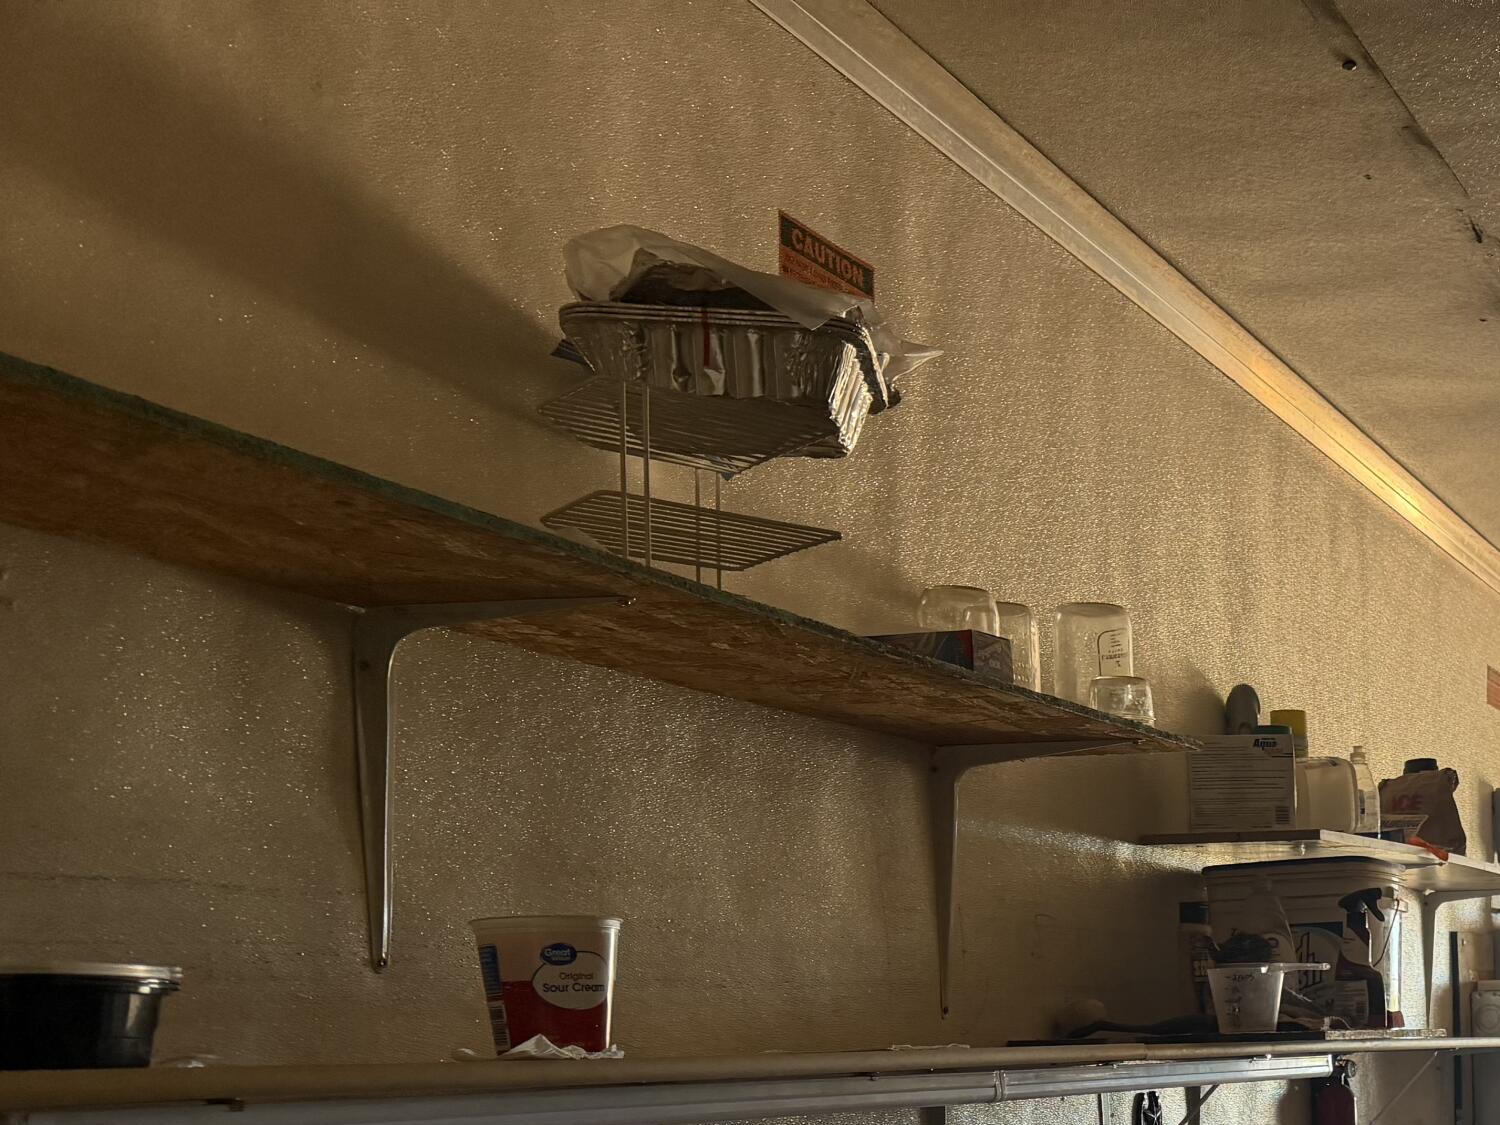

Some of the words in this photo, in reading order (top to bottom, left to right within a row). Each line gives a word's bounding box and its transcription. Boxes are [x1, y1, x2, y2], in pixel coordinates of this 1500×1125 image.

[791, 228, 864, 288] CAUTION
[1253, 738, 1277, 751] Aqua
[544, 948, 571, 957] Great
[559, 972, 594, 982] Original
[543, 983, 569, 993] Sour
[572, 983, 605, 992] Cream
